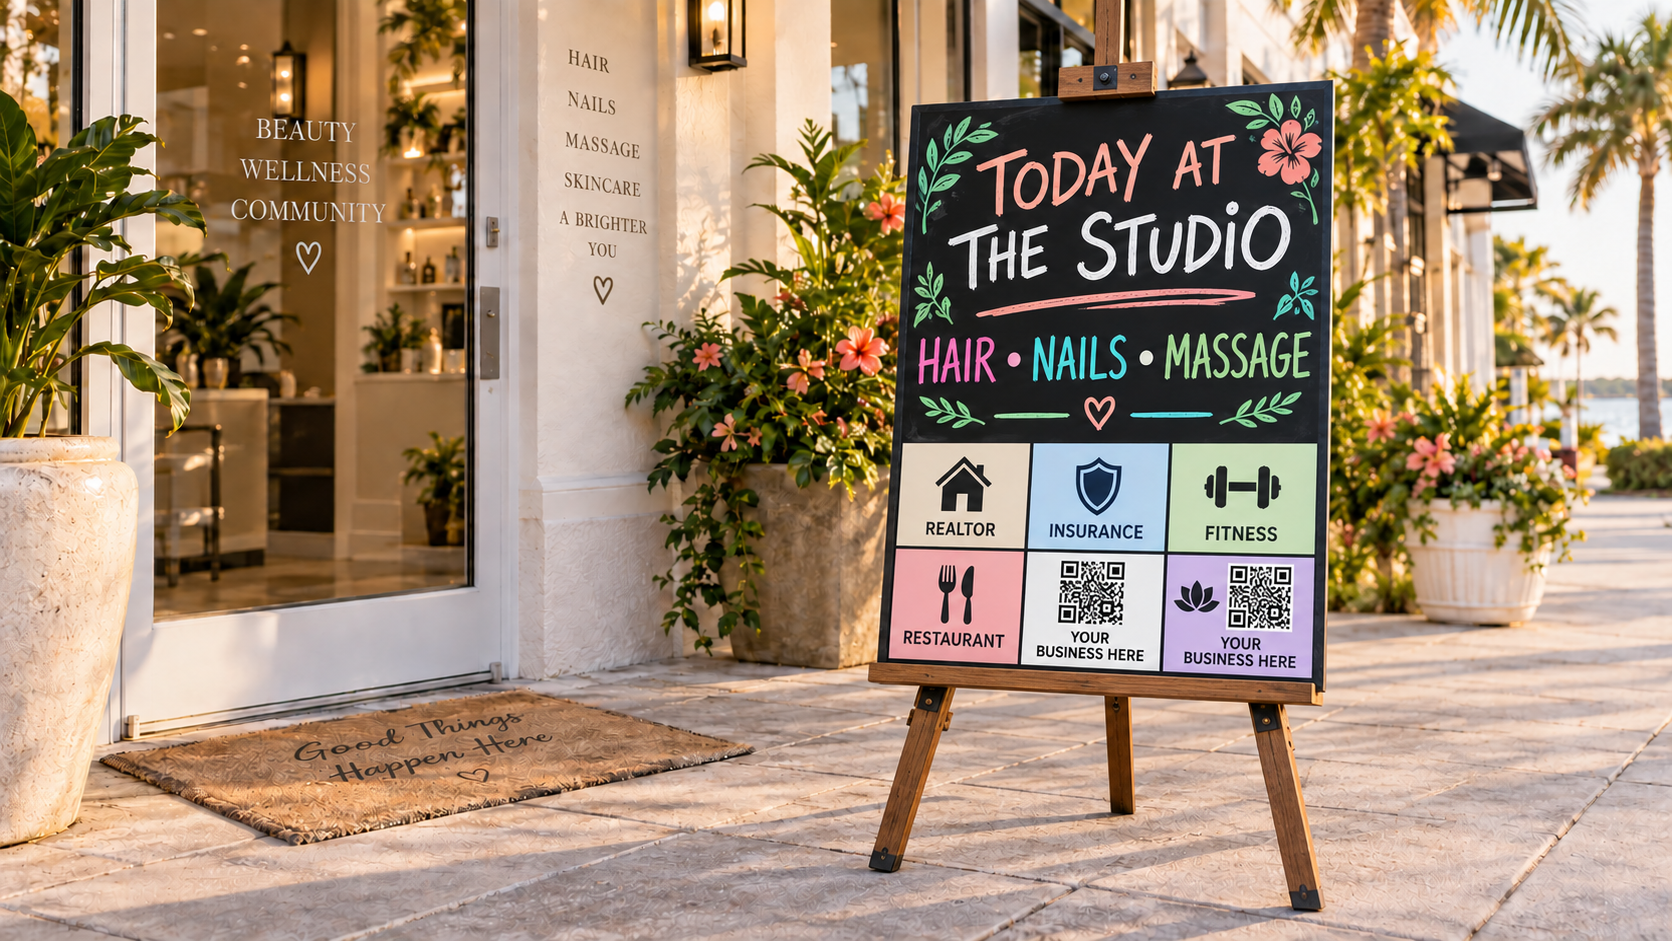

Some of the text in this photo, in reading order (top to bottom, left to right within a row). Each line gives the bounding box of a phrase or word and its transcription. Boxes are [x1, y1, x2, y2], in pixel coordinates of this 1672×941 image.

[568, 49, 610, 74] HAIR
[567, 90, 616, 115] NAILS
[256, 118, 357, 143] BEAUTY
[565, 132, 640, 159] MASSAGE
[240, 158, 371, 184] WELLNESS
[976, 133, 1237, 217] TODAY AT
[564, 171, 641, 197] SKINCARE
[230, 199, 386, 224] COMMUNITY
[559, 211, 648, 235] A BRIGHTER
[588, 241, 617, 259] YOU
[947, 224, 1049, 290] THE
[918, 331, 1312, 385] HAIR NAILS MASSAGE
[925, 521, 996, 538] REALTOR
[1048, 523, 1144, 541] INSURANCE
[1205, 525, 1278, 542] FITNESS
[903, 630, 1005, 649] RESTAURANT
[1070, 630, 1110, 646] YOUR
[1220, 636, 1262, 651] YOUR
[1036, 645, 1145, 662] BUSINESS HERE
[1183, 650, 1297, 669] BUSINESS HERE
[294, 712, 525, 762] Good Things
[329, 732, 553, 783] Happen Here
